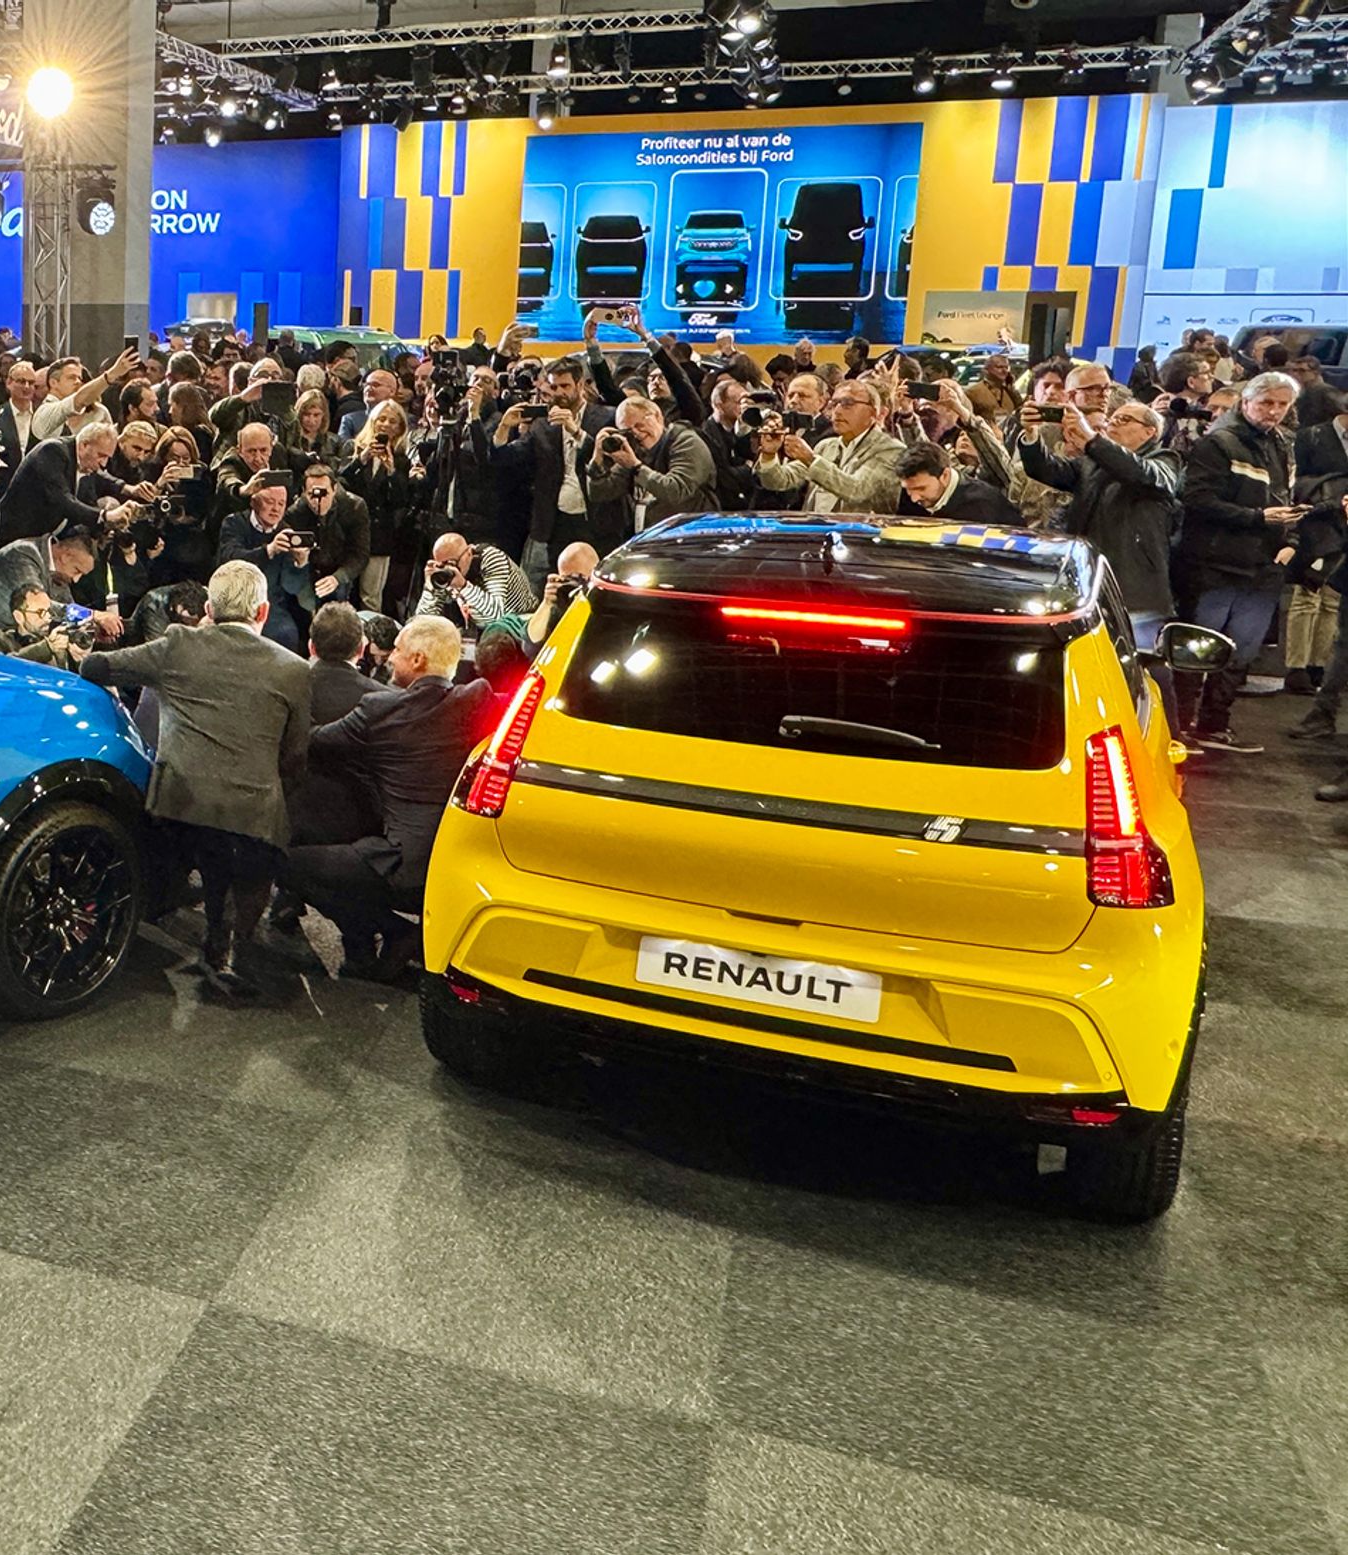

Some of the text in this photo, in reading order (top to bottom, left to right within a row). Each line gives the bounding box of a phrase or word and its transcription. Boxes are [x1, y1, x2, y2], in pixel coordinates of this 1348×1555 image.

[641, 133, 791, 150] Profiteer nu al van de
[636, 149, 794, 166] Saloncondities bij Ford
[150, 189, 188, 210] ON
[150, 212, 221, 234] RROW
[662, 951, 852, 1004] RENAULT
